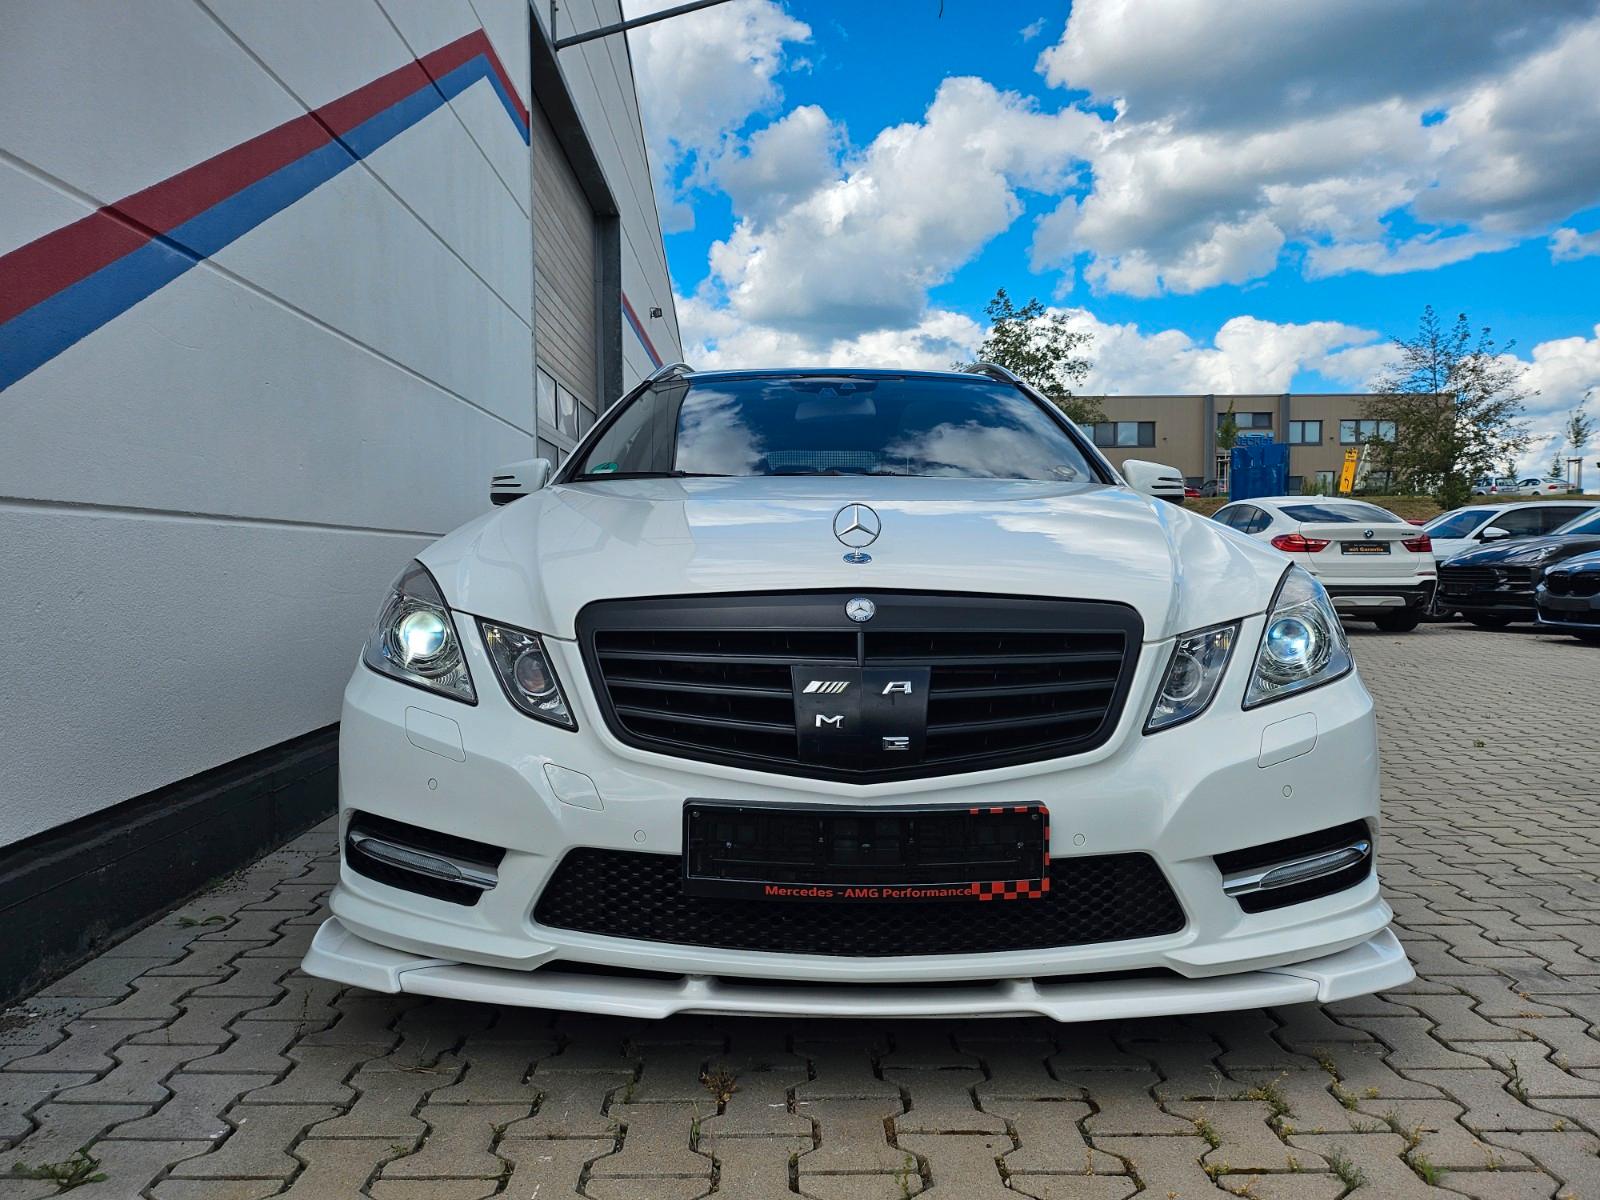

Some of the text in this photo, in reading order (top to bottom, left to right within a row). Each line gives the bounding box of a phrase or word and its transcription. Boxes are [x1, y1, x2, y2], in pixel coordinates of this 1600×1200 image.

[882, 681, 912, 695] A
[815, 714, 845, 729] M
[765, 885, 834, 898] Mercedes
[882, 887, 972, 898] Performance
